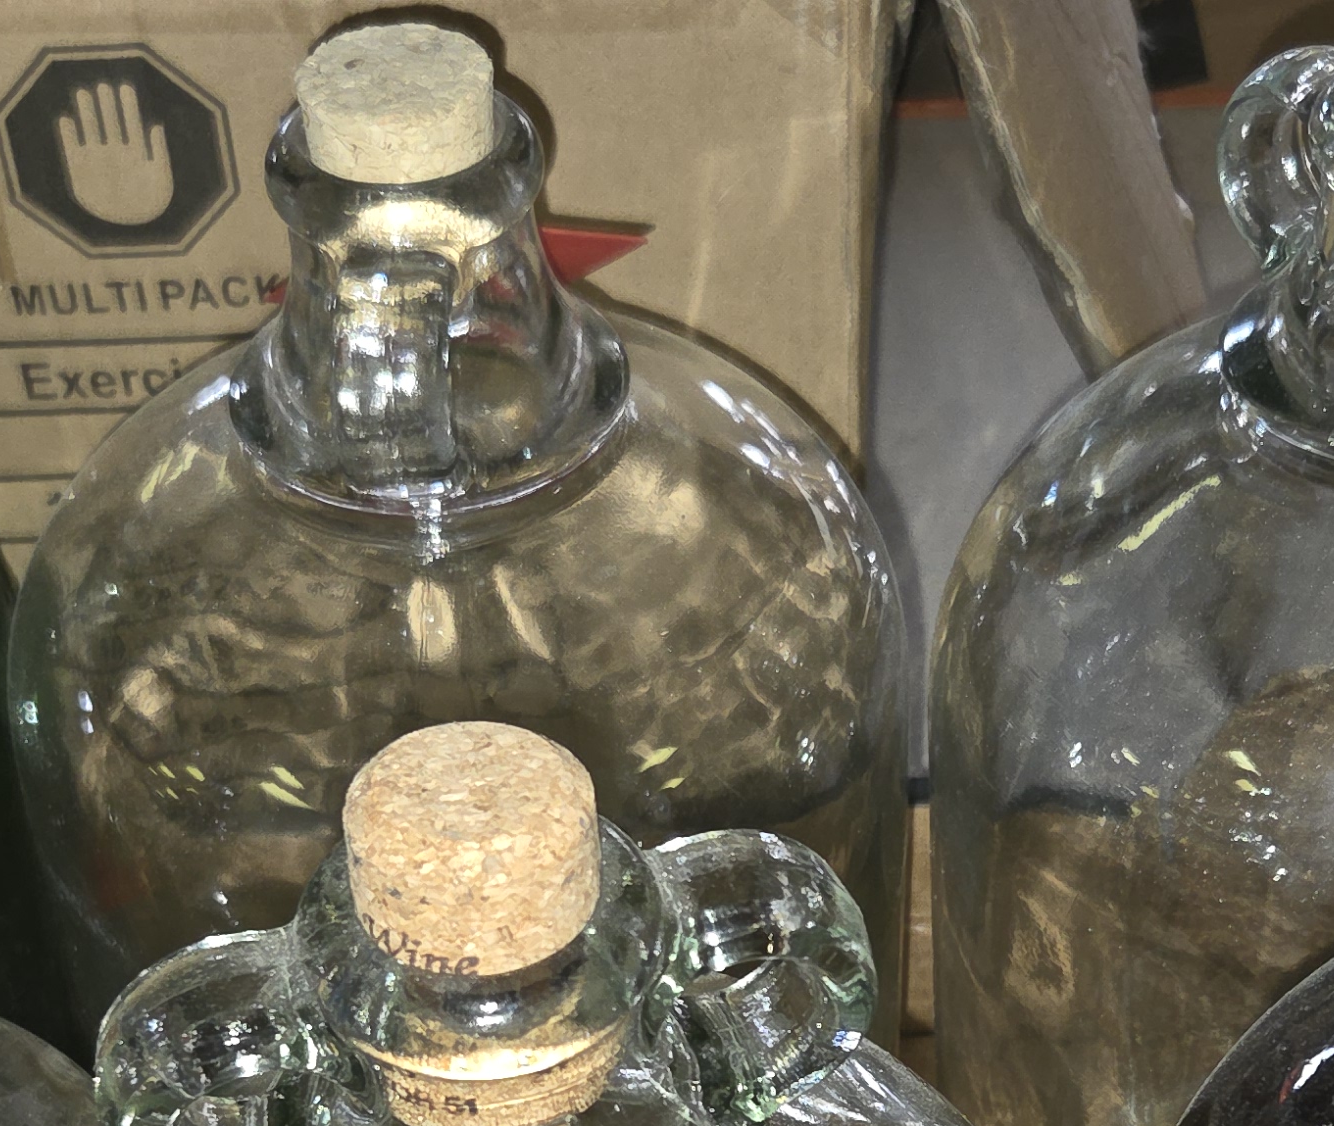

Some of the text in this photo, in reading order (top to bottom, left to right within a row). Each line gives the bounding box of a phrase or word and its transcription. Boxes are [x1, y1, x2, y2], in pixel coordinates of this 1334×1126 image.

[10, 274, 281, 317] MULTI PACK
[362, 912, 480, 977] Wine
